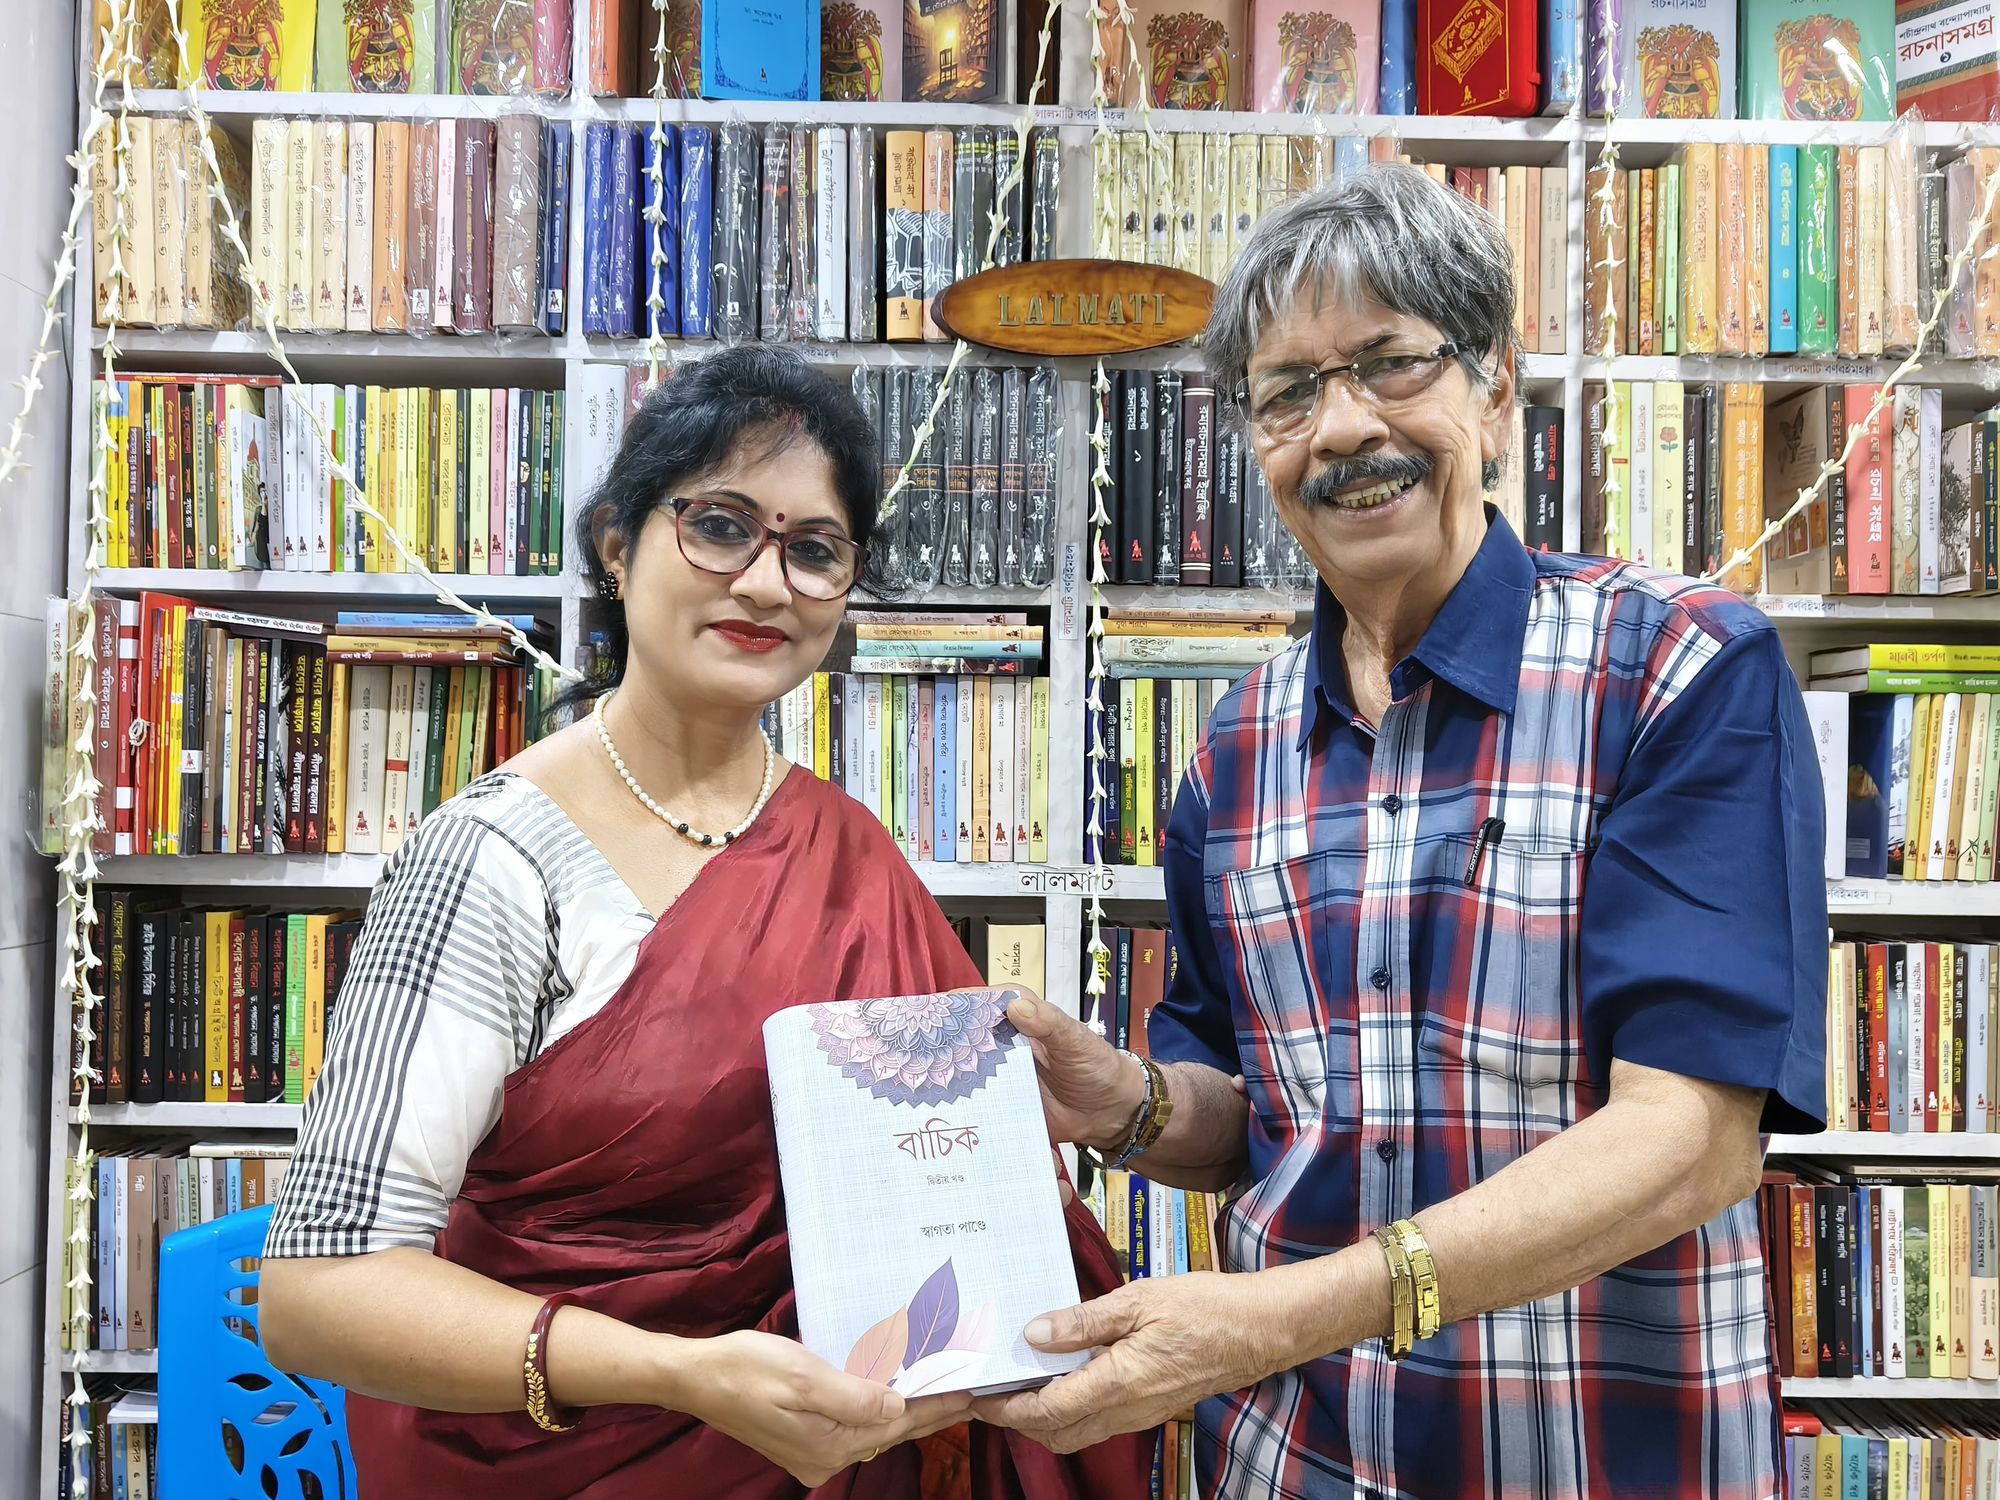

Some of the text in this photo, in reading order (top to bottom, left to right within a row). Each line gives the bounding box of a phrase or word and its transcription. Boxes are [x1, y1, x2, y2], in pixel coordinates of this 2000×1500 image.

[1898, 14, 1995, 61] রচনাসমগ্র
[998, 292, 1166, 326] LALMATI
[889, 388, 902, 459] স্বপনকুমার সমগ্র
[1006, 388, 1019, 434] স্বপনকুমার
[1033, 387, 1046, 434] স্বপনকুমার
[1127, 387, 1142, 463] রচনাসমগ্র ১
[921, 438, 932, 459] সমগ্র
[951, 392, 964, 512] স্বপনকুমার সমগ্র ৪
[982, 439, 994, 460] সমগ্র
[1008, 437, 1019, 459] সমগ্র
[1183, 437, 1196, 490] হীরেন্দ্রনাথ দত্ত
[1195, 404, 1210, 522] রম্যরচনাসমগ্র ইন্দ্রজিৎ
[1228, 432, 1239, 504] সাক্ষাৎকার সংগ্রহ
[1868, 467, 1883, 502] রচনা
[1831, 476, 1846, 548] নন্দলাল বসু
[1867, 504, 1883, 544] সংগ্রহ
[1061, 545, 1076, 636] লালমাটি বর্ণবইমহল
[295, 655, 307, 694] অরণ্যের
[1889, 650, 1919, 664] মানবী
[312, 656, 325, 696] অরণ্যের
[292, 696, 306, 733] আড়ালে
[310, 697, 324, 734] আড়ালে
[1106, 704, 1118, 763] তিনটি তারার কথা
[292, 751, 305, 774] লীলা
[309, 753, 323, 775] লীলা
[289, 776, 302, 813] মজুমদার
[307, 777, 319, 814] মজুমদার
[1018, 864, 1116, 892] লালমাটি
[113, 900, 126, 939] গোয়েন্দা
[112, 943, 127, 972] হাজির
[142, 945, 155, 972] উপন্যাস
[232, 932, 246, 998] কিশোর-অপরাধী
[1956, 955, 1965, 976] আজ
[142, 973, 156, 996] সিরিজ
[1955, 1001, 1964, 1019] এবং
[893, 1118, 979, 1161] বাচিক
[920, 1220, 987, 1239] স্বাগতা পাণ্ডে
